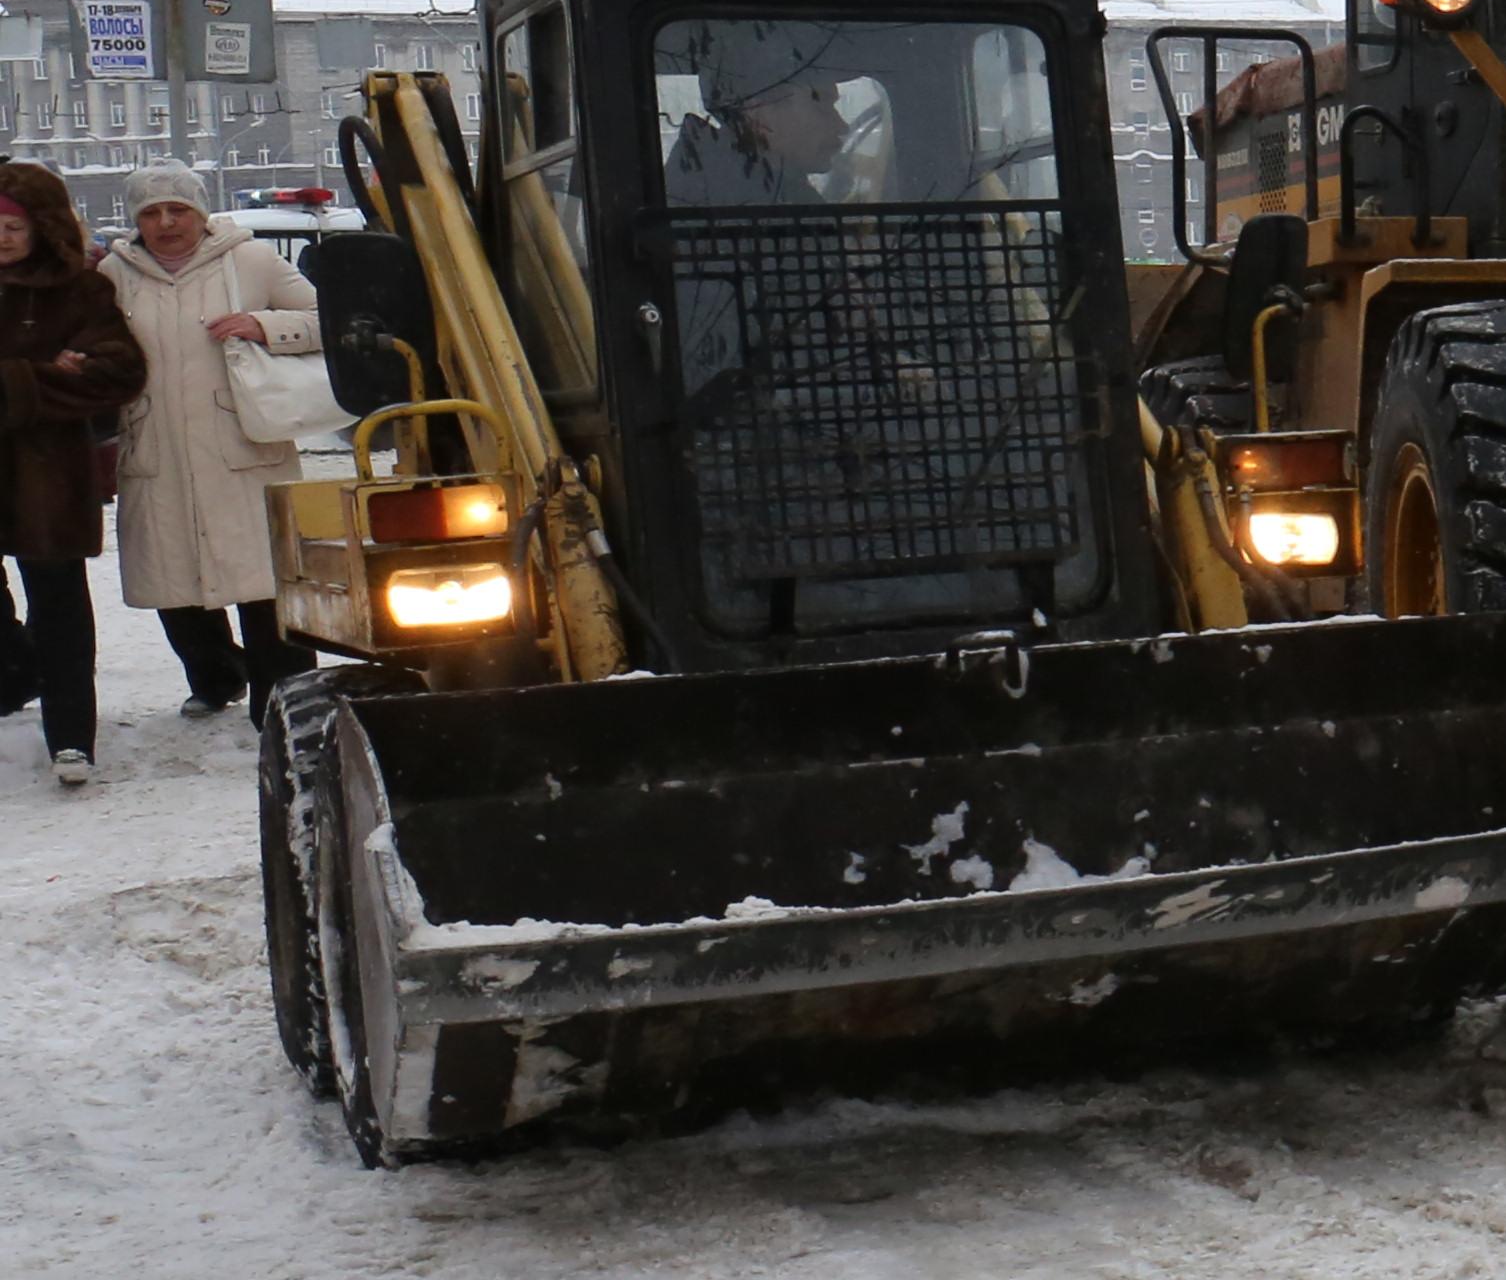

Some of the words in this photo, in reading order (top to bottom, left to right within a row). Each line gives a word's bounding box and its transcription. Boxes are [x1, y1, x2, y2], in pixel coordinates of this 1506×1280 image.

[88, 5, 114, 16] 17-18
[90, 18, 144, 36] ВОЛОСЫ
[91, 39, 146, 52] 75000
